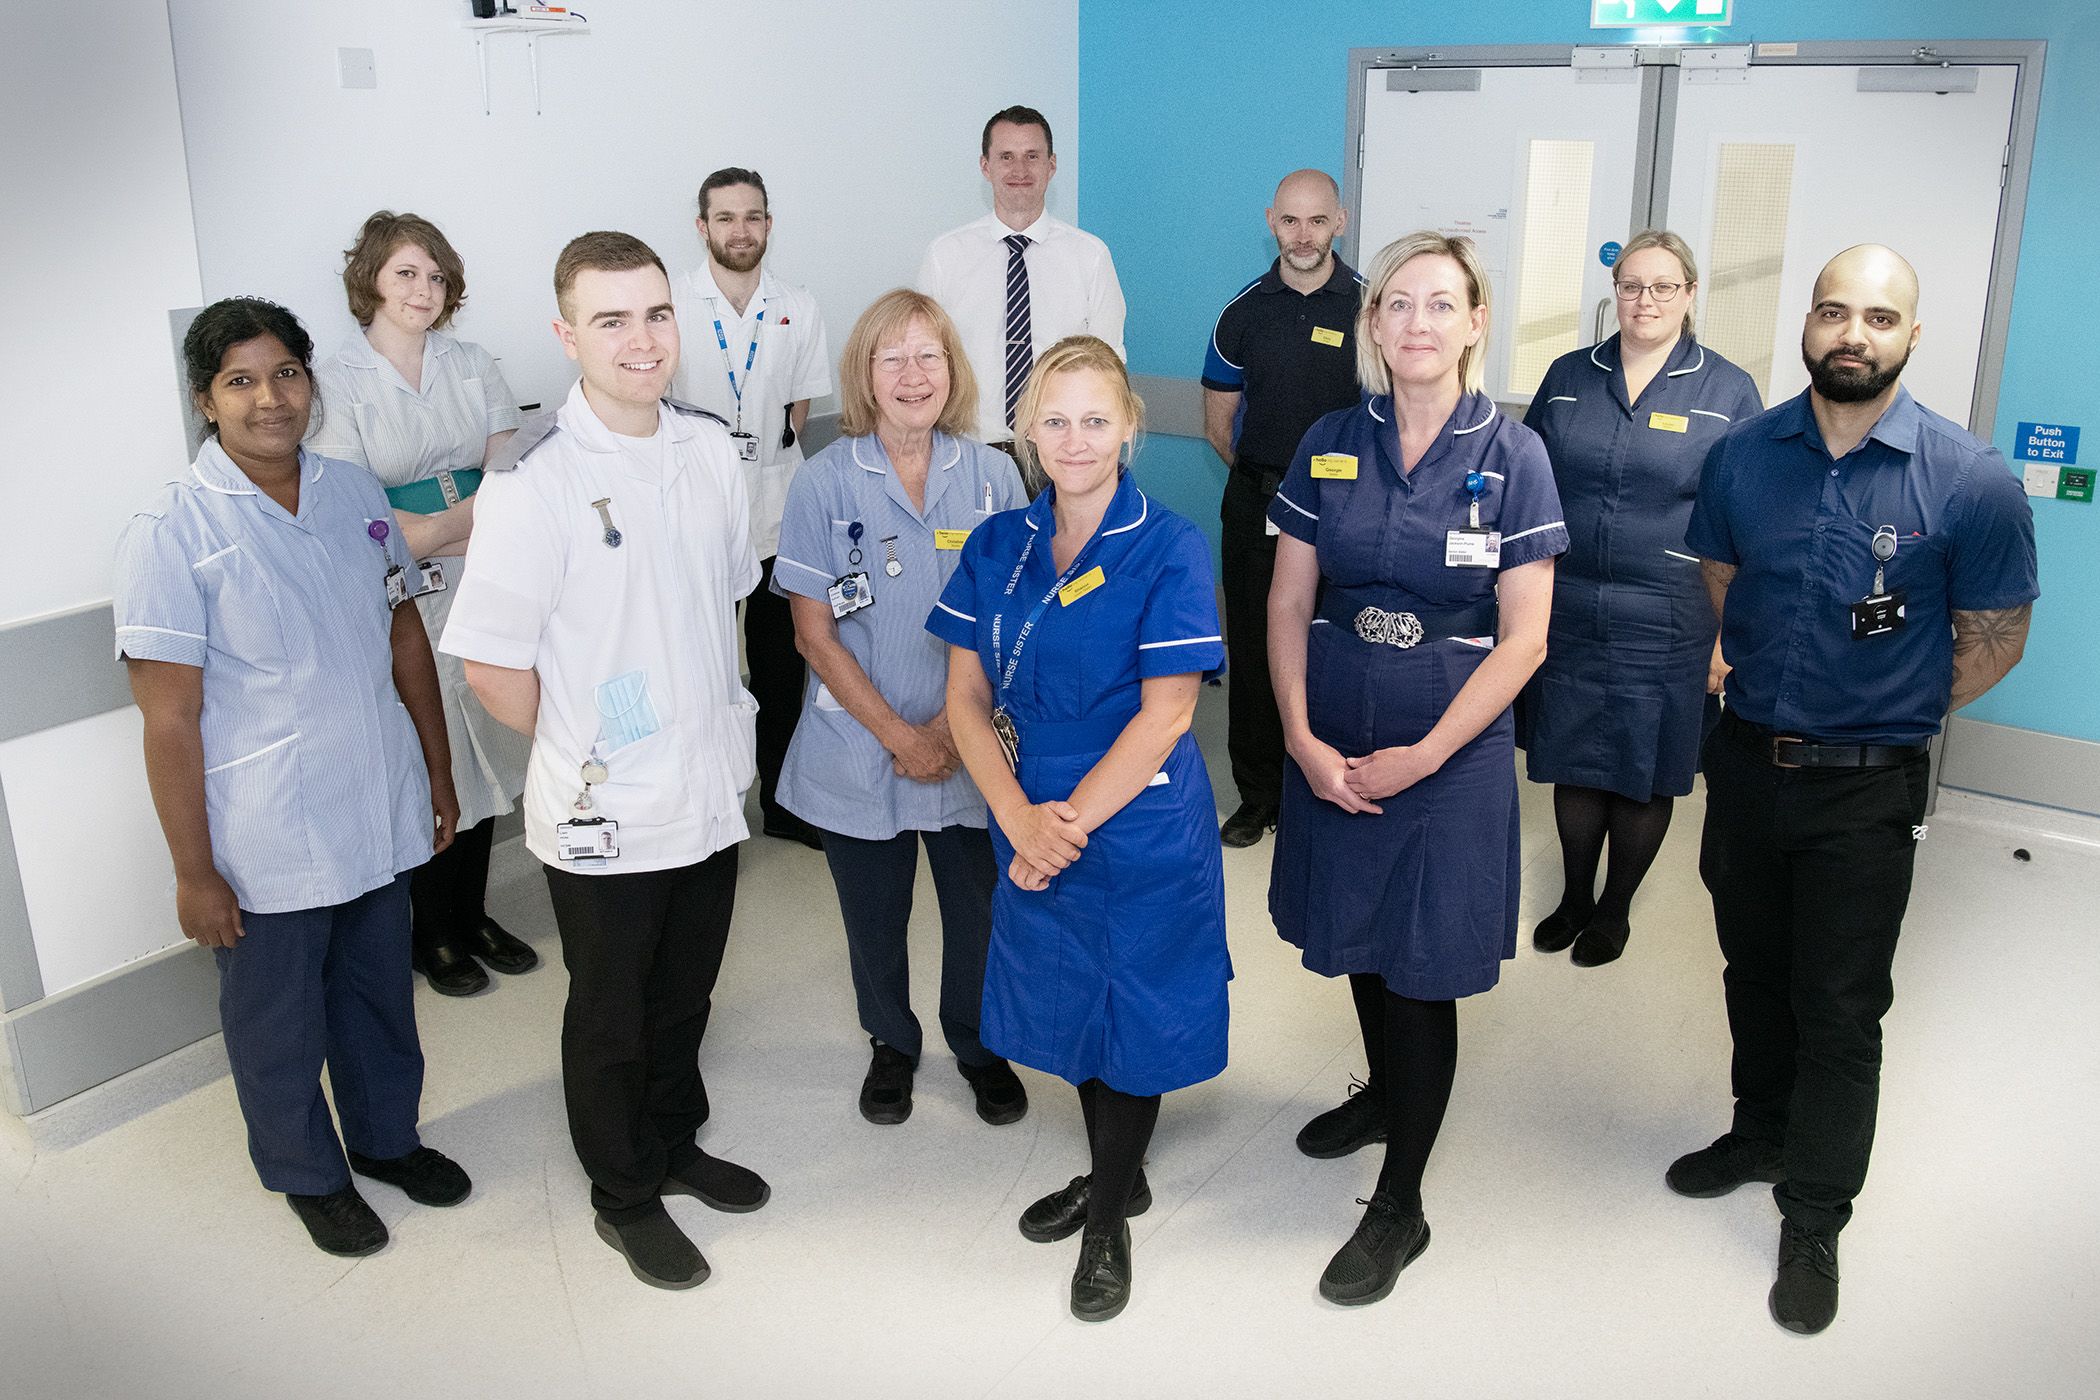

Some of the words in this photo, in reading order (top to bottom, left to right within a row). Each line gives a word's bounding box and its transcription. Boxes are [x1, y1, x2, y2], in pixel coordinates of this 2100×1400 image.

[2028, 436, 2065, 448] Button
[2035, 425, 2062, 436] Push
[2027, 447, 2038, 456] to
[2042, 448, 2064, 459] Exit
[1019, 533, 1036, 562] NURSE
[1004, 564, 1024, 595] SISTER
[1042, 577, 1068, 604] NURSE
[992, 613, 1003, 648] NURSE
[1002, 657, 1019, 690] NURSE
[1012, 620, 1035, 657] SISTER
